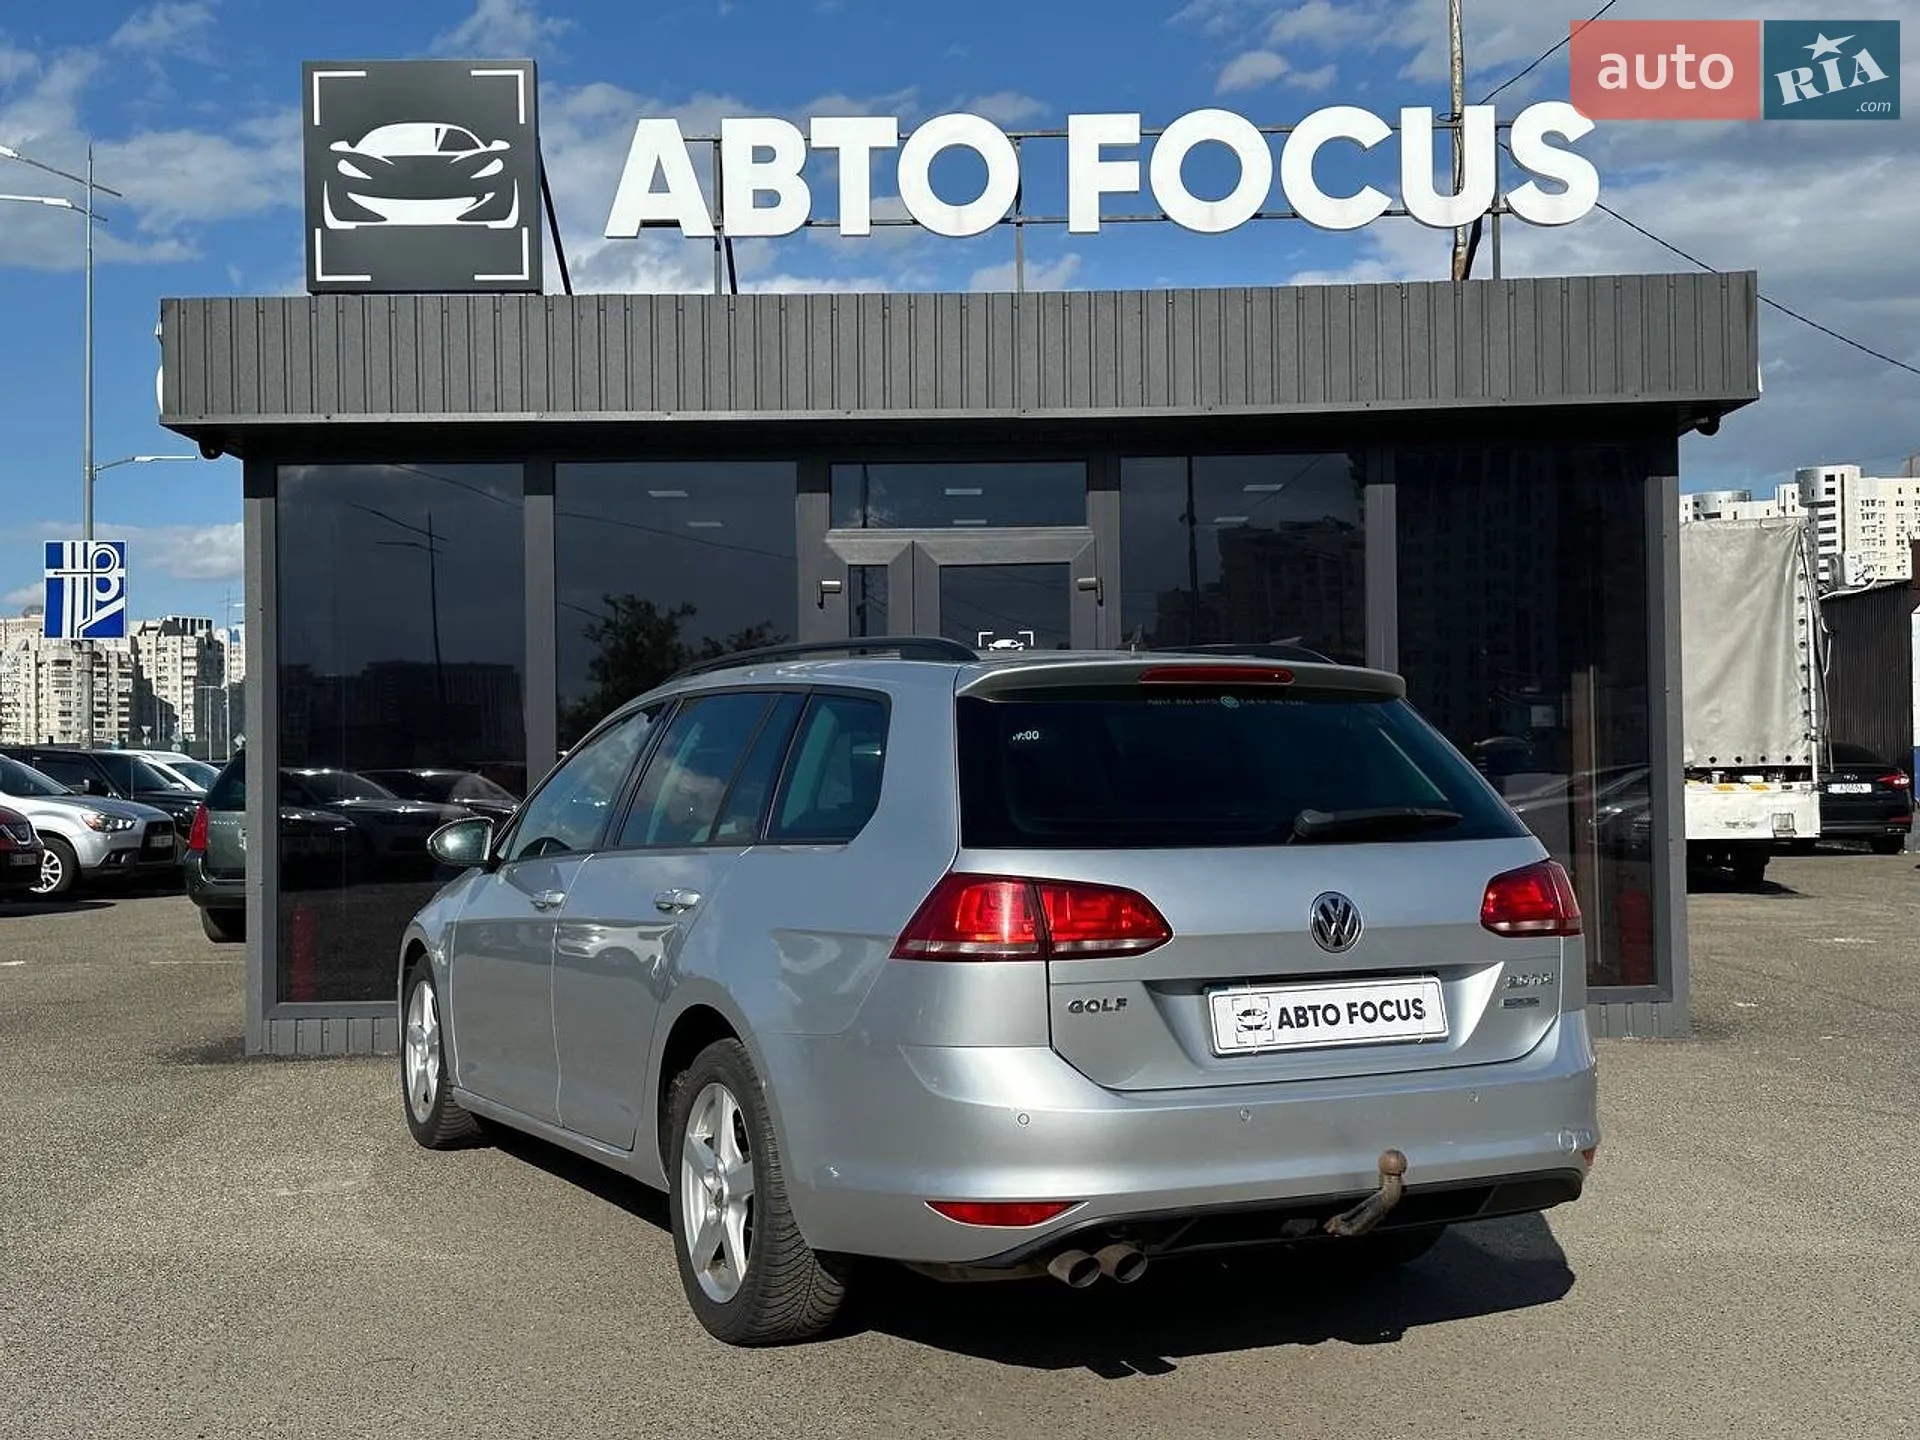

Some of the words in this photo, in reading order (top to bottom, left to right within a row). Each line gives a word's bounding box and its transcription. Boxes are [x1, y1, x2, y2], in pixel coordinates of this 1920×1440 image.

[605, 112, 1019, 238] АВТО
[1067, 101, 1600, 234] FOCUS
[1068, 997, 1127, 1013] GOLF
[1278, 1003, 1341, 1029] АВТО
[1346, 998, 1426, 1024] FOCUS
